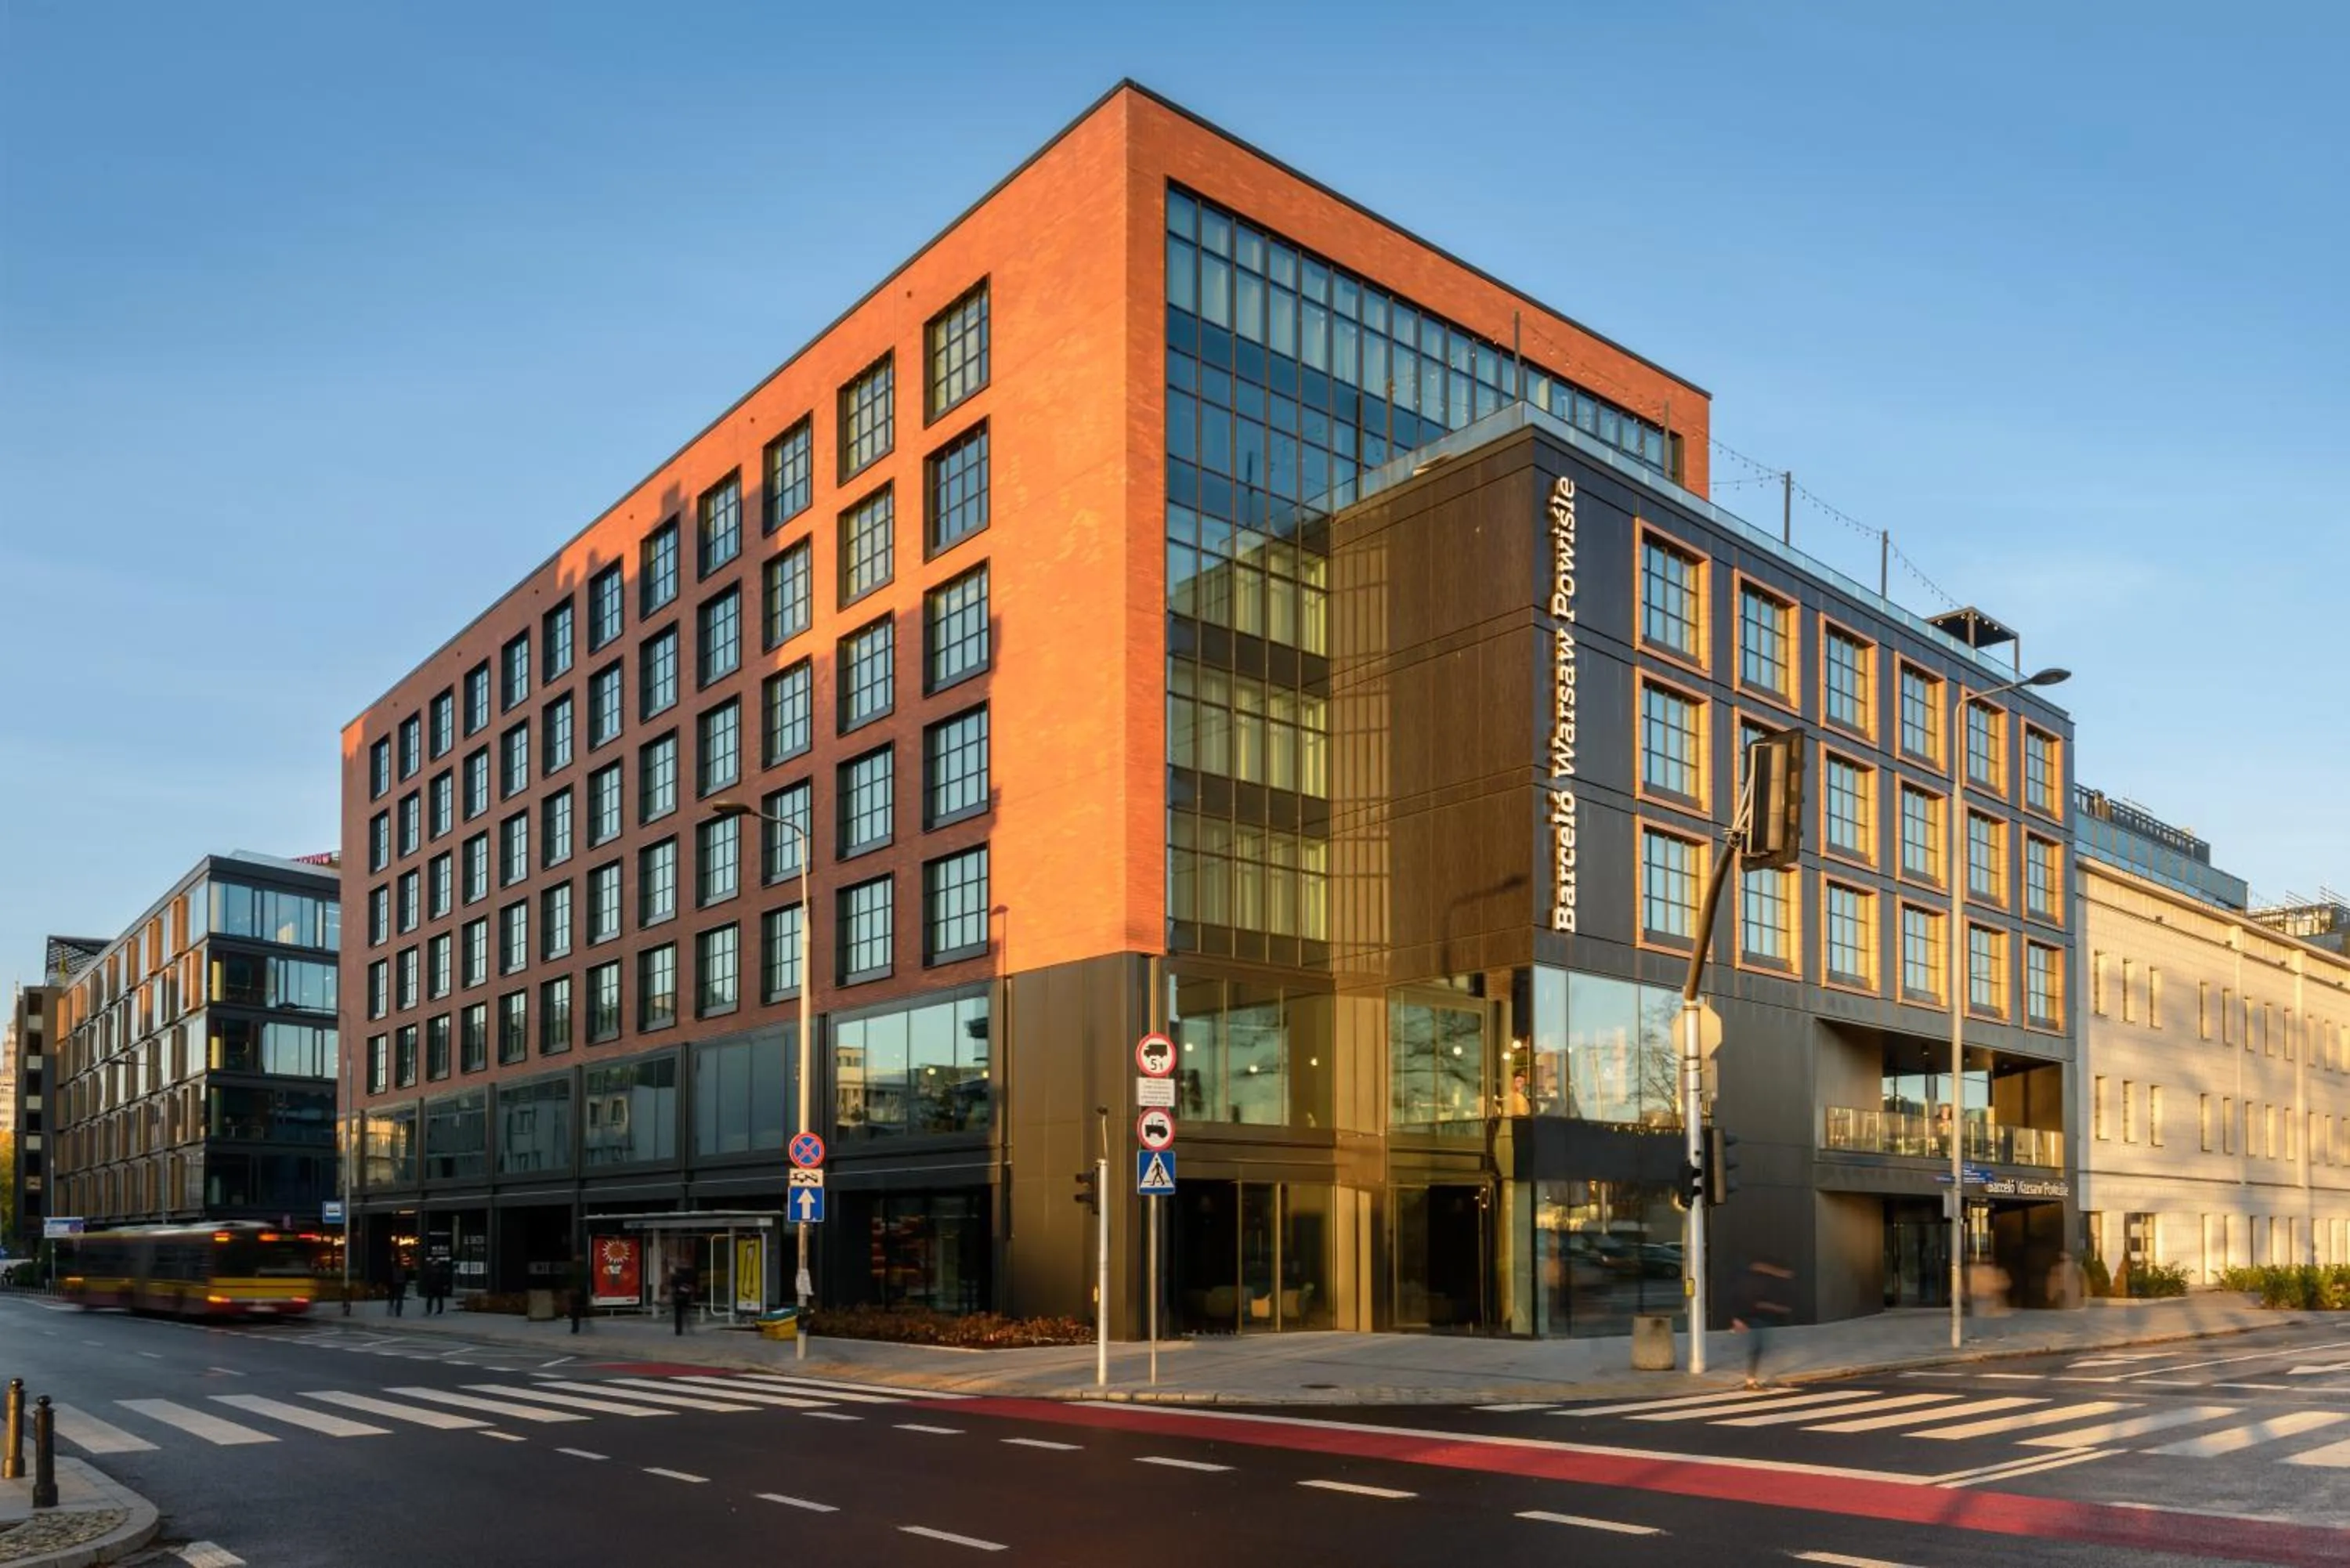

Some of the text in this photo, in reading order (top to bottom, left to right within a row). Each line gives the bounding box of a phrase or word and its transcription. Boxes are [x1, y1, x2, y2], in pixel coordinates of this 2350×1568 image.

[1552, 476, 1576, 933] Barceló Warsaw Powiśle
[1151, 1058, 1157, 1071] 5
